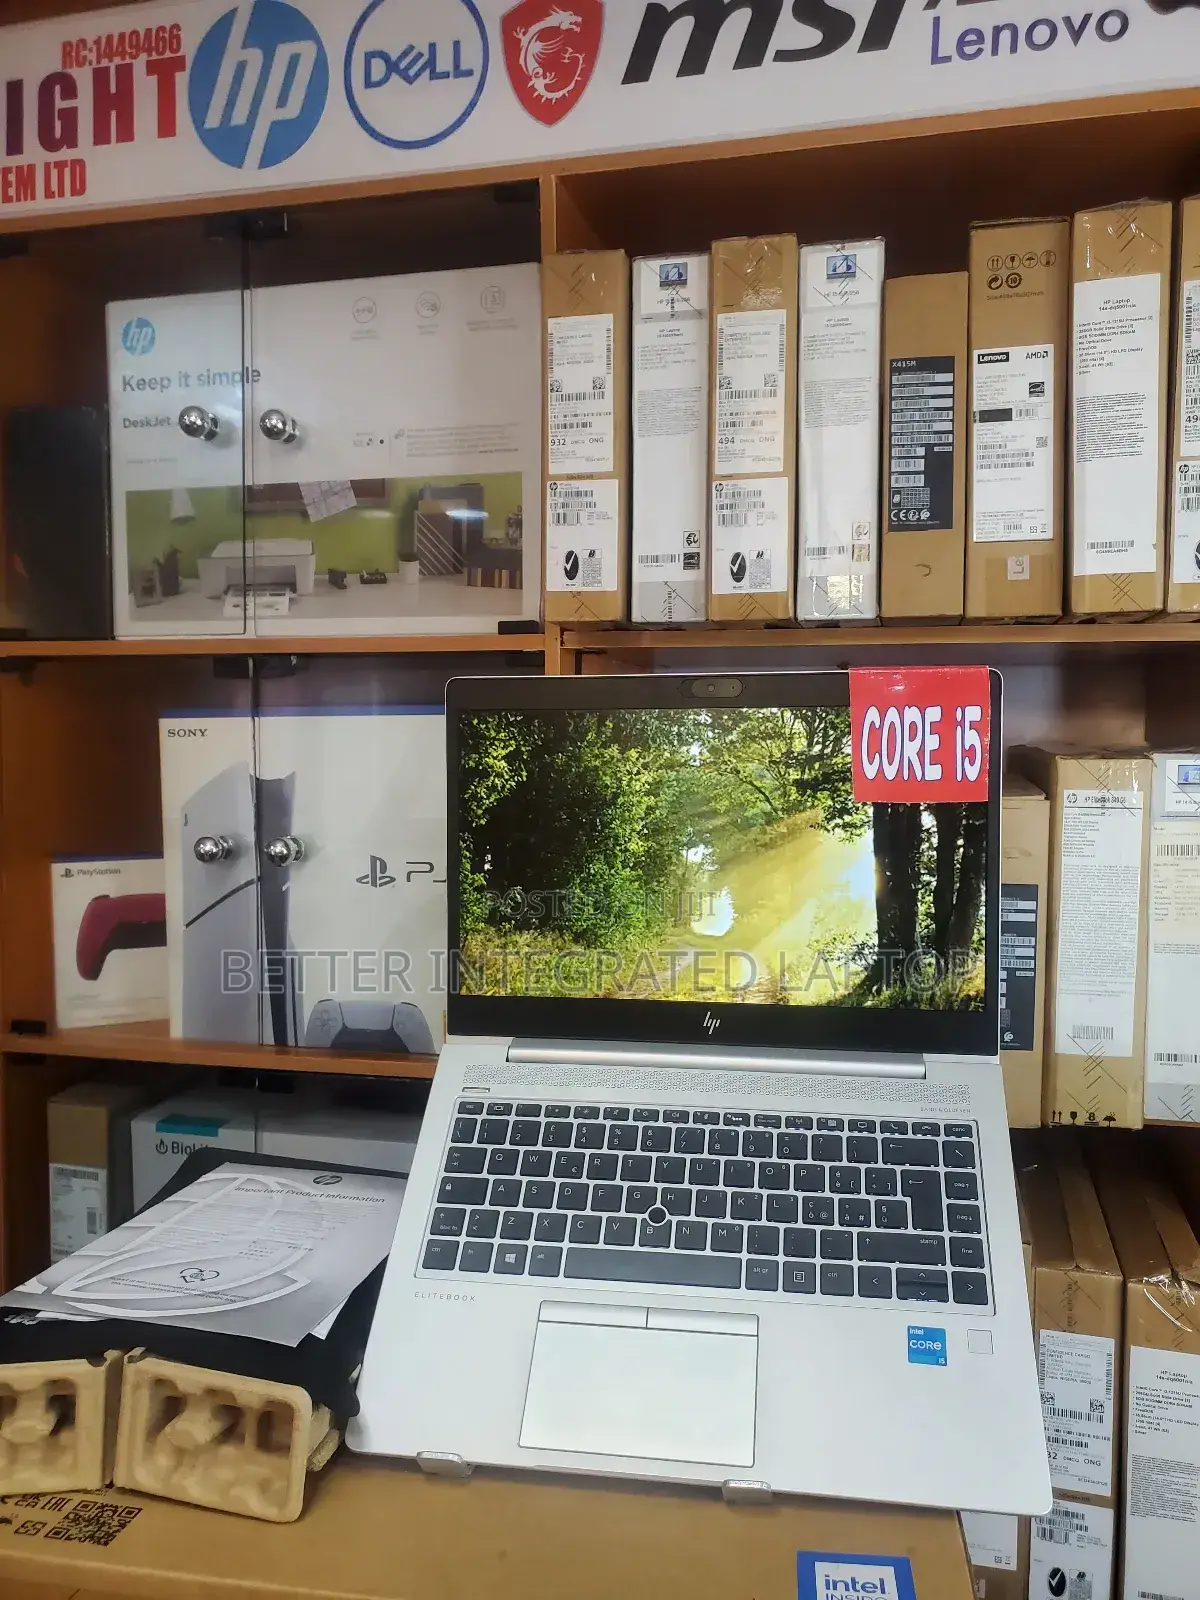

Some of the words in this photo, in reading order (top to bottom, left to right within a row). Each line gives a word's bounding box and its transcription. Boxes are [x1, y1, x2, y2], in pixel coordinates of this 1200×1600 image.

[61, 24, 182, 69] RC:1449466
[931, 9, 1129, 66] Lenovo
[364, 38, 474, 90] DELL
[204, 0, 316, 170] hp
[5, 55, 187, 157] IGHT
[44, 157, 87, 199] LTD
[121, 317, 157, 356] hp
[892, 360, 917, 368] X415M
[980, 354, 1007, 362] Lenovo
[1026, 351, 1042, 360] AMD
[122, 372, 172, 394] Keep
[178, 370, 191, 389] it
[197, 366, 262, 390] simple
[122, 416, 171, 430] DeskJet
[550, 438, 567, 447] 932
[718, 436, 735, 445] 494
[167, 728, 208, 738] SONY
[860, 704, 943, 783] CORE
[955, 704, 984, 784] i5
[77, 868, 121, 877] PlayStation
[495, 1153, 503, 1161] Q
[529, 1155, 539, 1163] W
[560, 1156, 568, 1164] E
[235, 1186, 285, 1195] Important
[285, 1190, 324, 1198] Product
[325, 1193, 386, 1203] Information
[531, 1186, 538, 1194] S
[564, 1187, 572, 1195] D
[633, 1191, 641, 1199] G
[667, 1193, 675, 1201] H
[737, 1197, 745, 1206] K
[507, 1217, 515, 1225] Z
[542, 1219, 550, 1227] X
[576, 1220, 585, 1229] C
[612, 1222, 620, 1230] V
[646, 1226, 654, 1234] B
[682, 1227, 690, 1235] N
[718, 1229, 727, 1237] M
[414, 1291, 476, 1302] ELITEBOOK
[1083, 1458, 1101, 1467] ONG
[824, 1573, 887, 1595] intel
